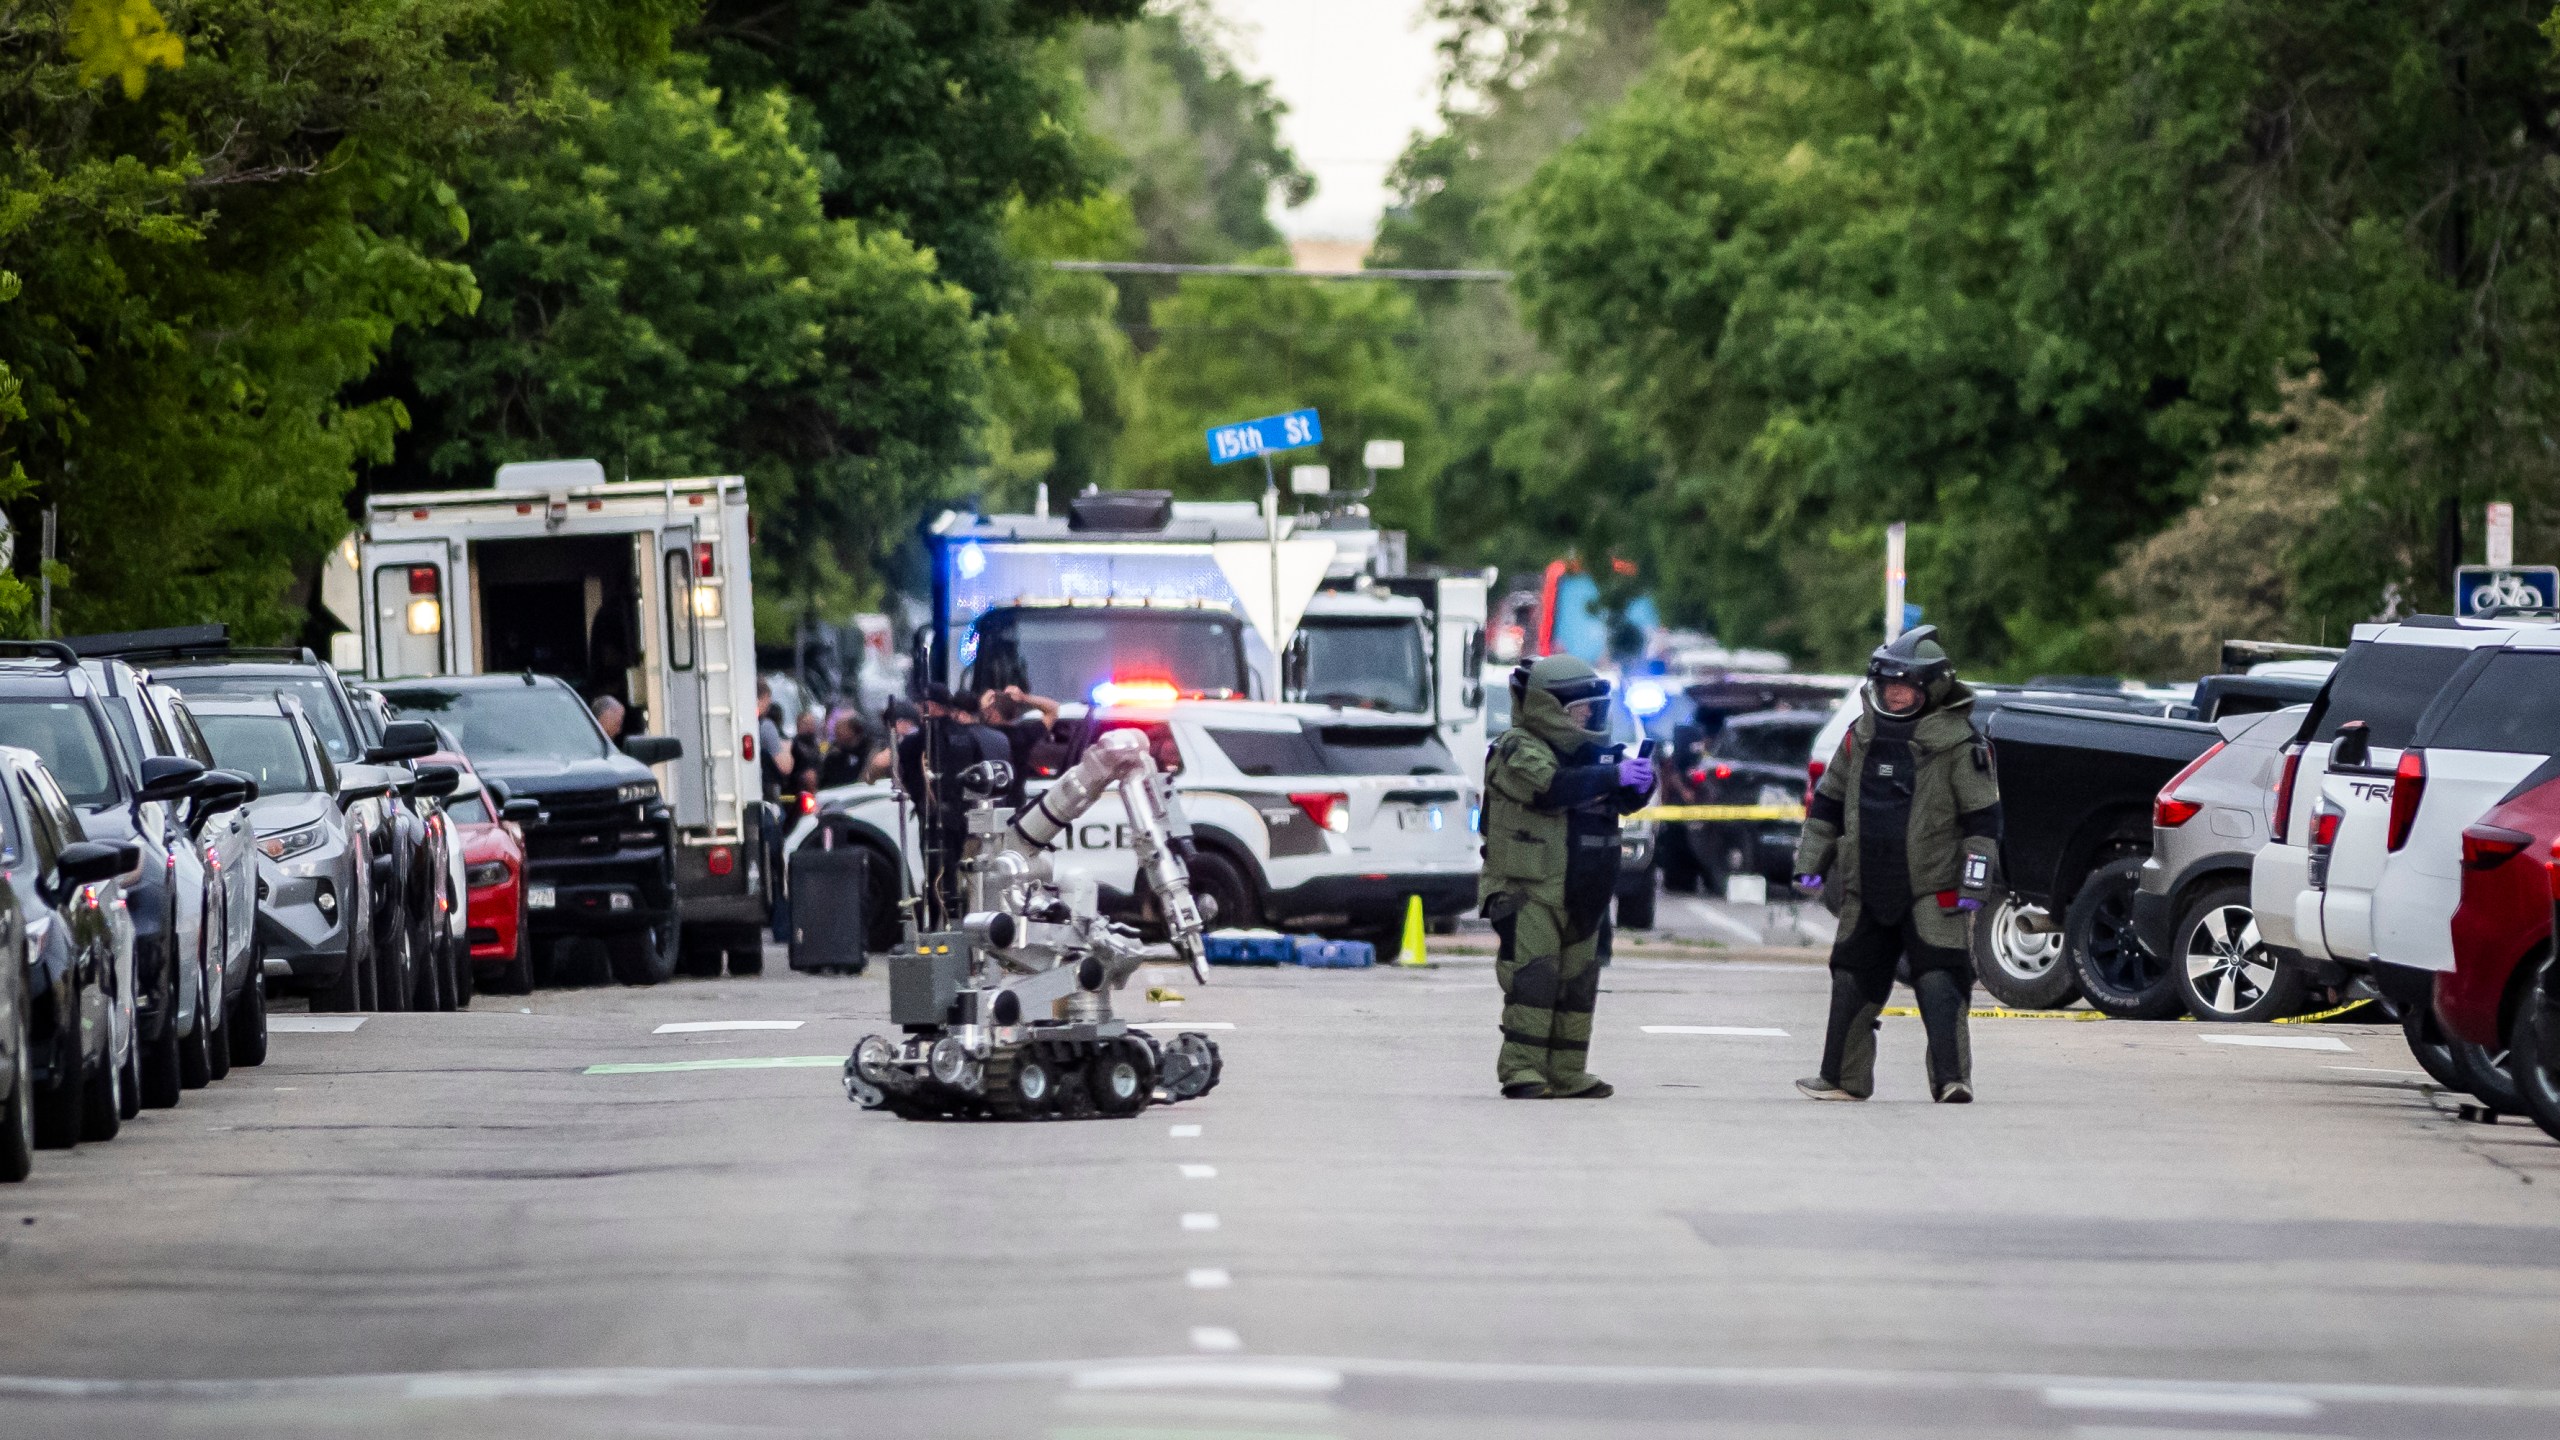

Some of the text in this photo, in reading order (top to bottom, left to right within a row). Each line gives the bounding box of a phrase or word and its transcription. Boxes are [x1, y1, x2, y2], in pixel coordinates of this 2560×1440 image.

[1215, 415, 1312, 458] 15th St
[1056, 823, 1134, 850] ICE
